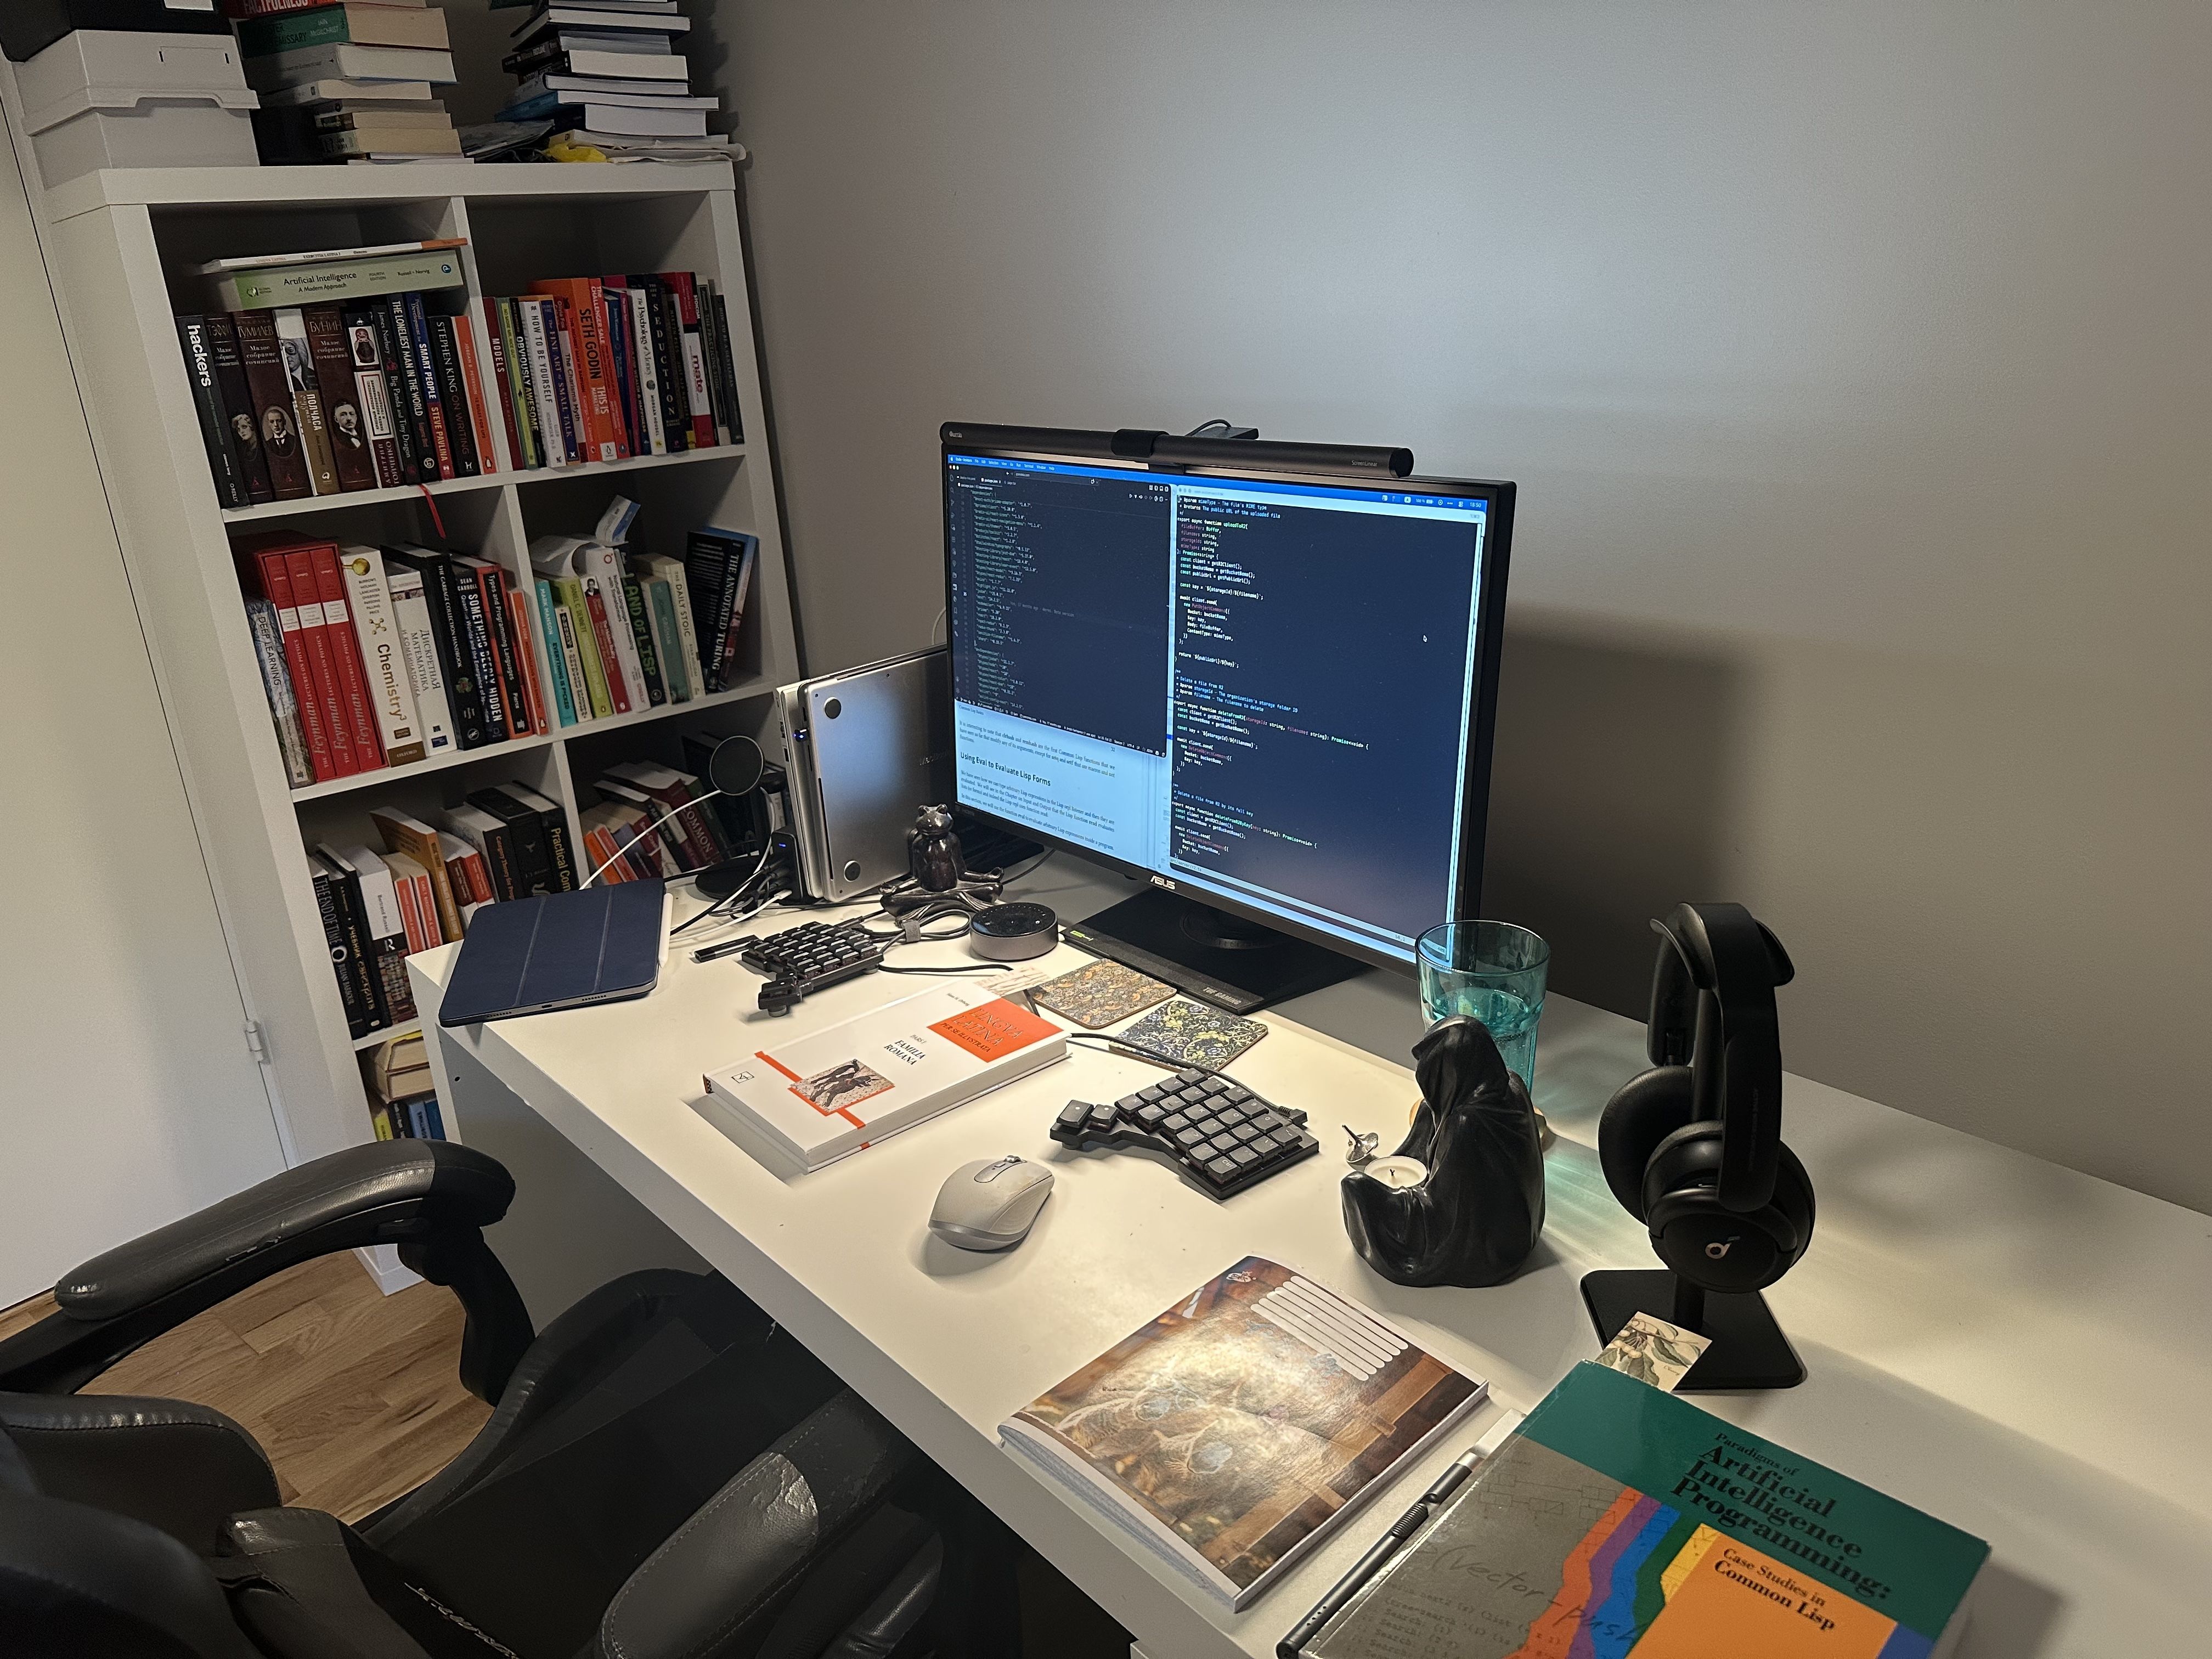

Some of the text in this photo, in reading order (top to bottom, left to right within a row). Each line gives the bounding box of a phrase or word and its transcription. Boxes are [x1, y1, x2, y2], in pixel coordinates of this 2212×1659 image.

[284, 272, 357, 285] Artificial Intelligence
[309, 321, 342, 333] БУНИН
[392, 301, 403, 314] THE
[637, 307, 647, 344] Psychology
[395, 315, 409, 349] LONELIEST
[579, 308, 602, 379] SETH GODIN
[188, 325, 211, 387] hackers
[403, 351, 413, 368] MAN
[419, 343, 436, 399] SMART PEOPLE
[492, 338, 505, 373] MODELS
[532, 315, 552, 403] HOW TO BE YOURSELF
[693, 355, 703, 393] mate
[408, 379, 417, 392] THE
[411, 392, 423, 416] WORLD
[437, 321, 469, 455] STEPHEN KING ON WRITING
[516, 336, 531, 385] OBVIOUSLY
[524, 387, 538, 431] AWESOME
[550, 331, 558, 352] FINE
[559, 383, 568, 411] SMALL
[564, 414, 572, 437] TALK
[597, 386, 607, 405] THIS
[307, 394, 322, 431] ПОЛЧАСА
[393, 388, 403, 407] Panda
[399, 420, 407, 433] Tiny
[431, 407, 448, 461] STEVE PAVLINA
[441, 575, 449, 602] GARBAGE
[610, 588, 622, 623] Transformers
[444, 603, 456, 633] COLLECTION
[540, 588, 554, 635] MARK MANSON
[613, 575, 634, 650] Natural Language Processing
[620, 573, 656, 676] LAND OF LISP
[675, 584, 691, 637] DAILY STOIC
[712, 555, 739, 670] THE ANNOTATED TURING
[258, 616, 281, 686] DEEP LEARNING
[411, 633, 429, 692] МАТЕМАТИКА
[419, 629, 441, 690] ДИСКРЕТНАЯ
[452, 633, 462, 668] HANDBOOK
[494, 606, 505, 648] Programming
[502, 648, 514, 680] Languages
[552, 642, 564, 682] EVERYTHING
[327, 697, 347, 749] Feynman
[488, 687, 503, 721] HIDDEN
[306, 701, 325, 754] Feynman
[961, 752, 975, 764] Using
[977, 757, 987, 766] Eval
[996, 763, 1019, 776] Evaluate
[1020, 770, 1031, 782] Lisp
[1032, 774, 1051, 786] Forms
[551, 827, 566, 869] Practical
[1150, 876, 1175, 890] ASUS
[313, 878, 343, 945] THE END OF TIME
[377, 895, 386, 916] Bertrand
[348, 925, 362, 959] УЧЕБНИК
[1215, 992, 1242, 1005] GAMING
[953, 1015, 1006, 1046] LATINA
[970, 1008, 1023, 1039] LINGVA
[884, 1045, 917, 1065] ROMANA
[895, 1040, 926, 1059] FAMILIA
[1716, 1433, 1800, 1476] Paradigms of
[1699, 1445, 1837, 1518] Artificial
[1684, 1459, 1861, 1558] Intelligence
[1670, 1476, 1891, 1600] Programming:
[1714, 1560, 1835, 1631] Common Lisp
[1723, 1548, 1826, 1606] Case Studies in
